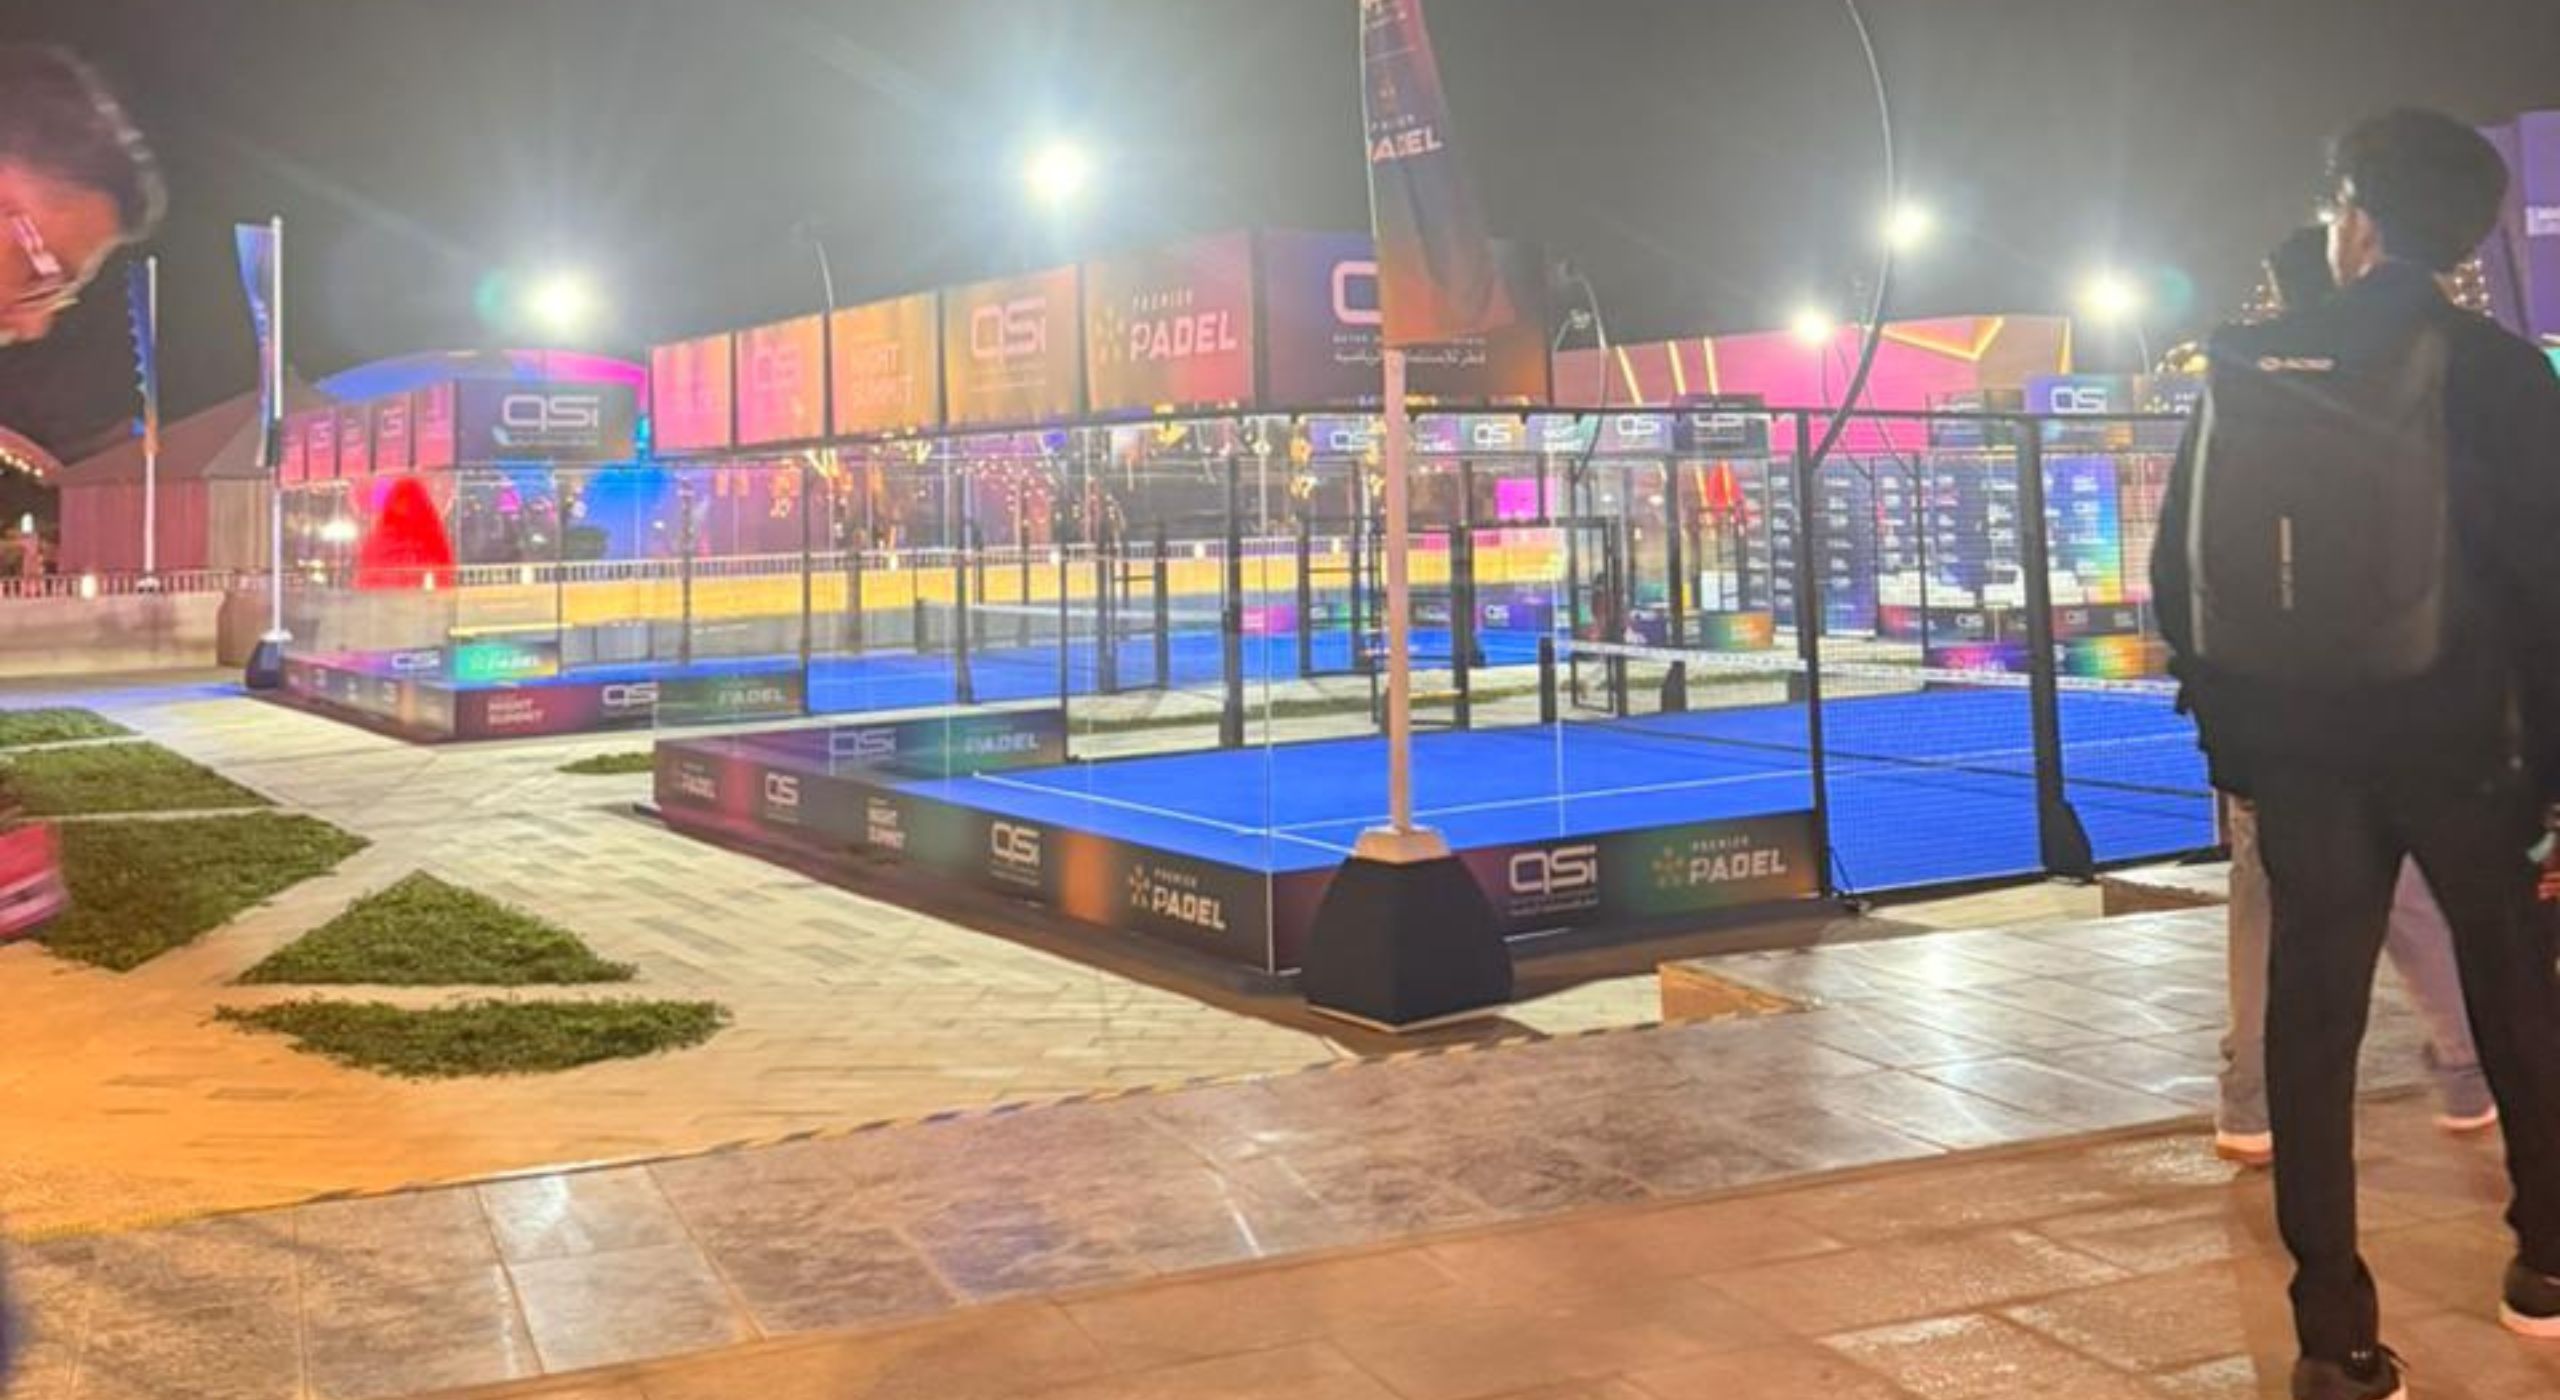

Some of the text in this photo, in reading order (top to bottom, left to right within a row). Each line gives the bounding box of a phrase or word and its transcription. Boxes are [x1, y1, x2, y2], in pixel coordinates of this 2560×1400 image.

[1130, 310, 1238, 362] PADEL
[1689, 849, 1787, 885] PADEL
[1152, 886, 1226, 931] PADEL
